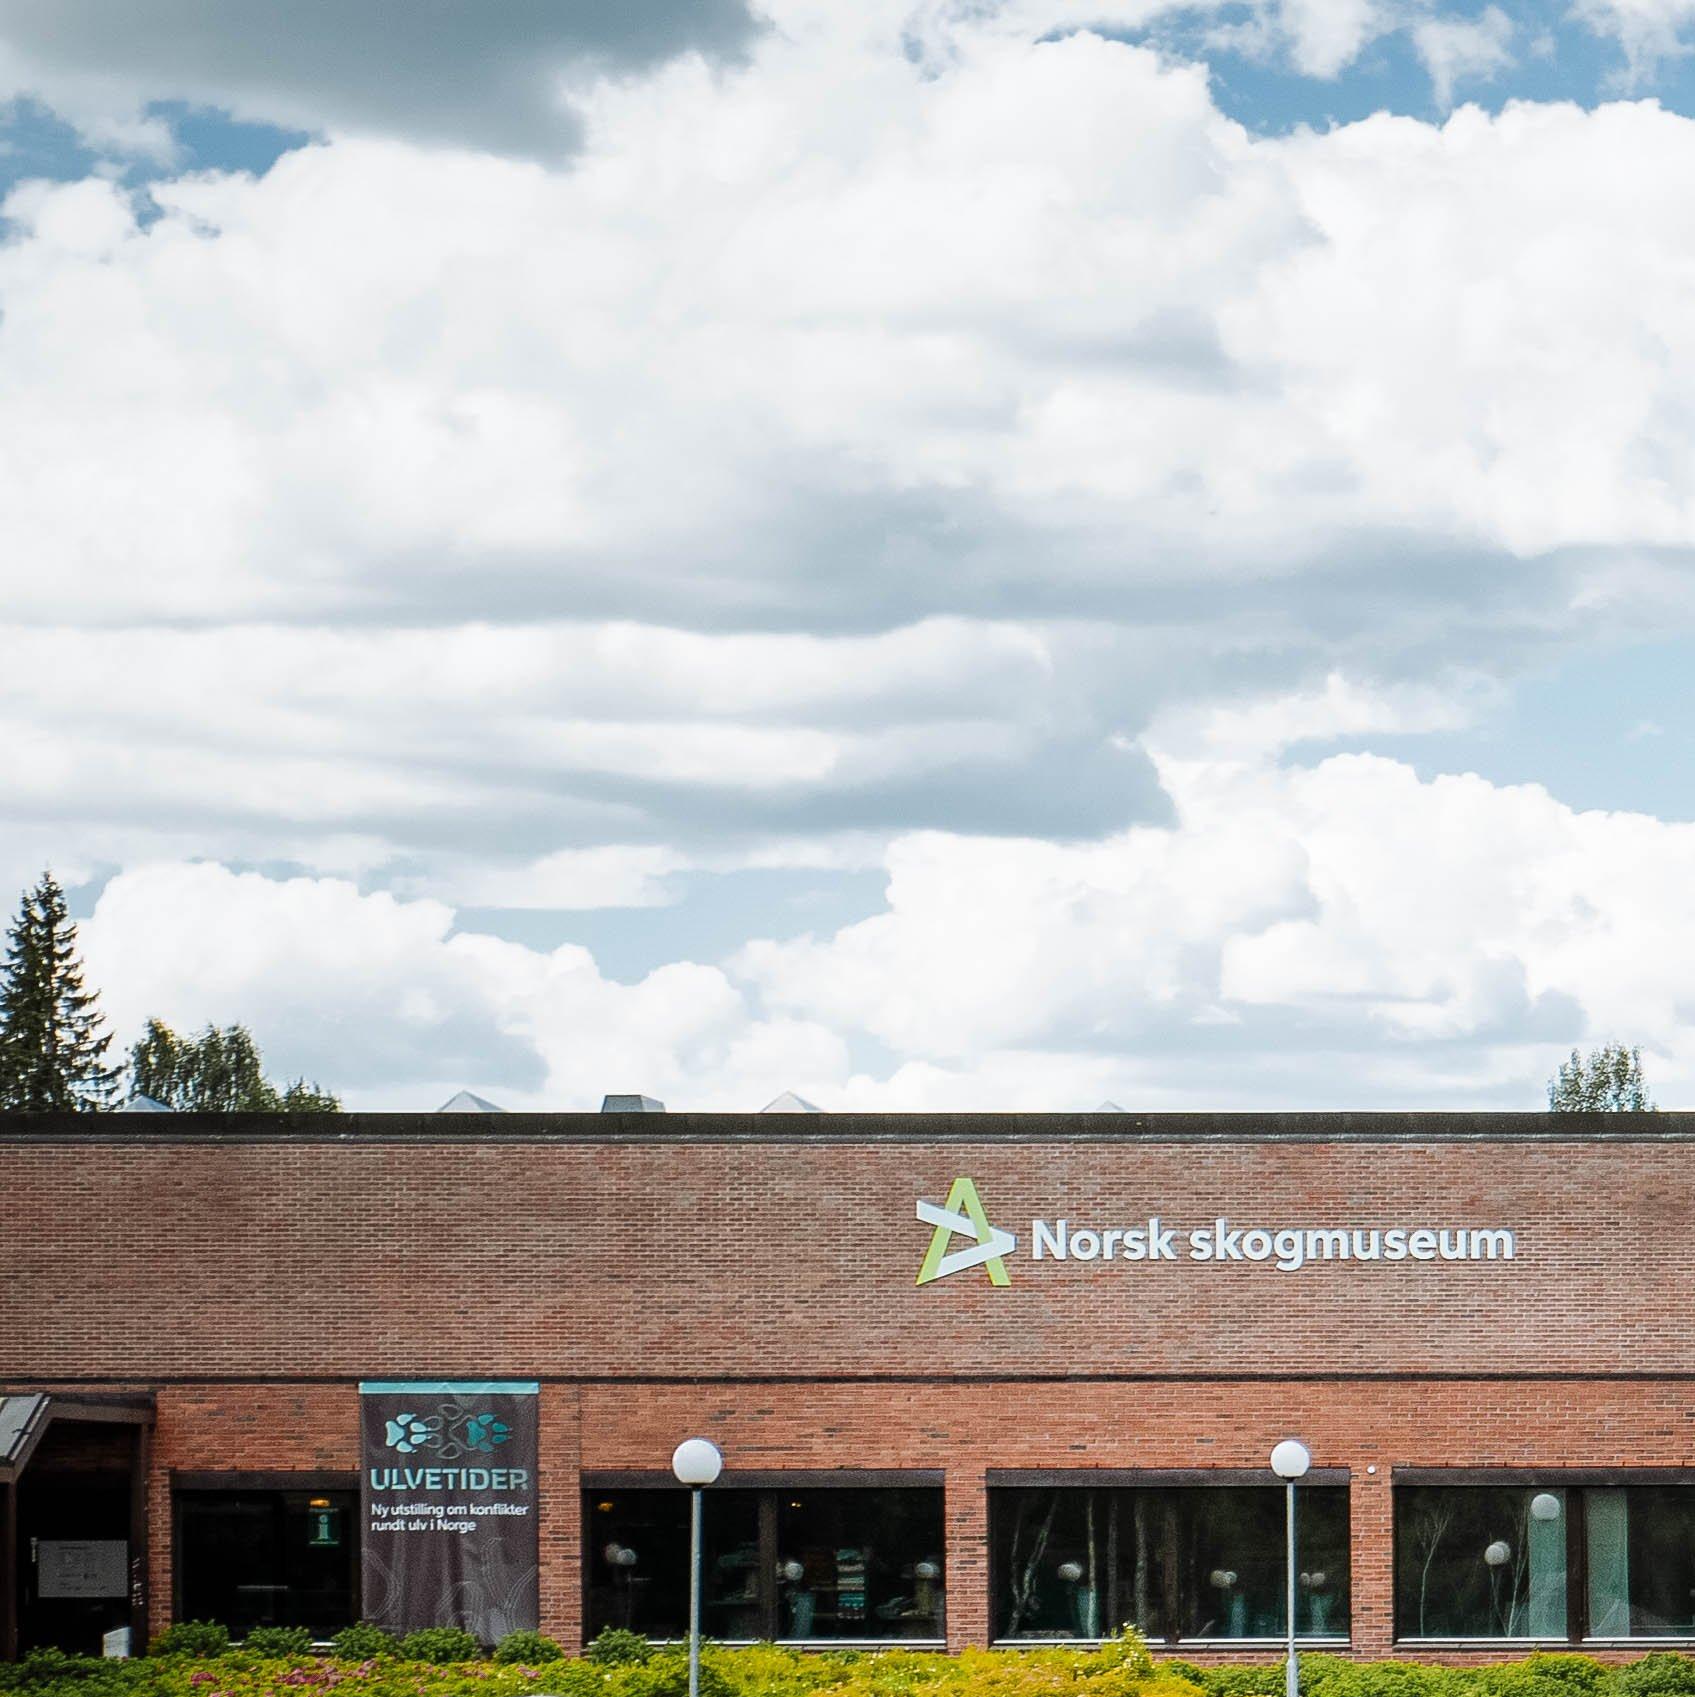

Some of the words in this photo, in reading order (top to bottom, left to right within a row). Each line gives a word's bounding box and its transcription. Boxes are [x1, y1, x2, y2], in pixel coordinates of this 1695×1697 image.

[1032, 1217, 1177, 1261] Norsk
[1189, 1217, 1515, 1272] skogmuseum
[370, 1467, 529, 1491] ULVETIDER
[371, 1503, 389, 1518] Ny
[391, 1503, 444, 1518] utstilling
[446, 1506, 467, 1516] om
[470, 1503, 529, 1516] konflikter
[371, 1519, 405, 1531] rundt
[408, 1519, 428, 1531] ulv
[430, 1519, 434, 1531] i
[437, 1519, 477, 1534] Norge
